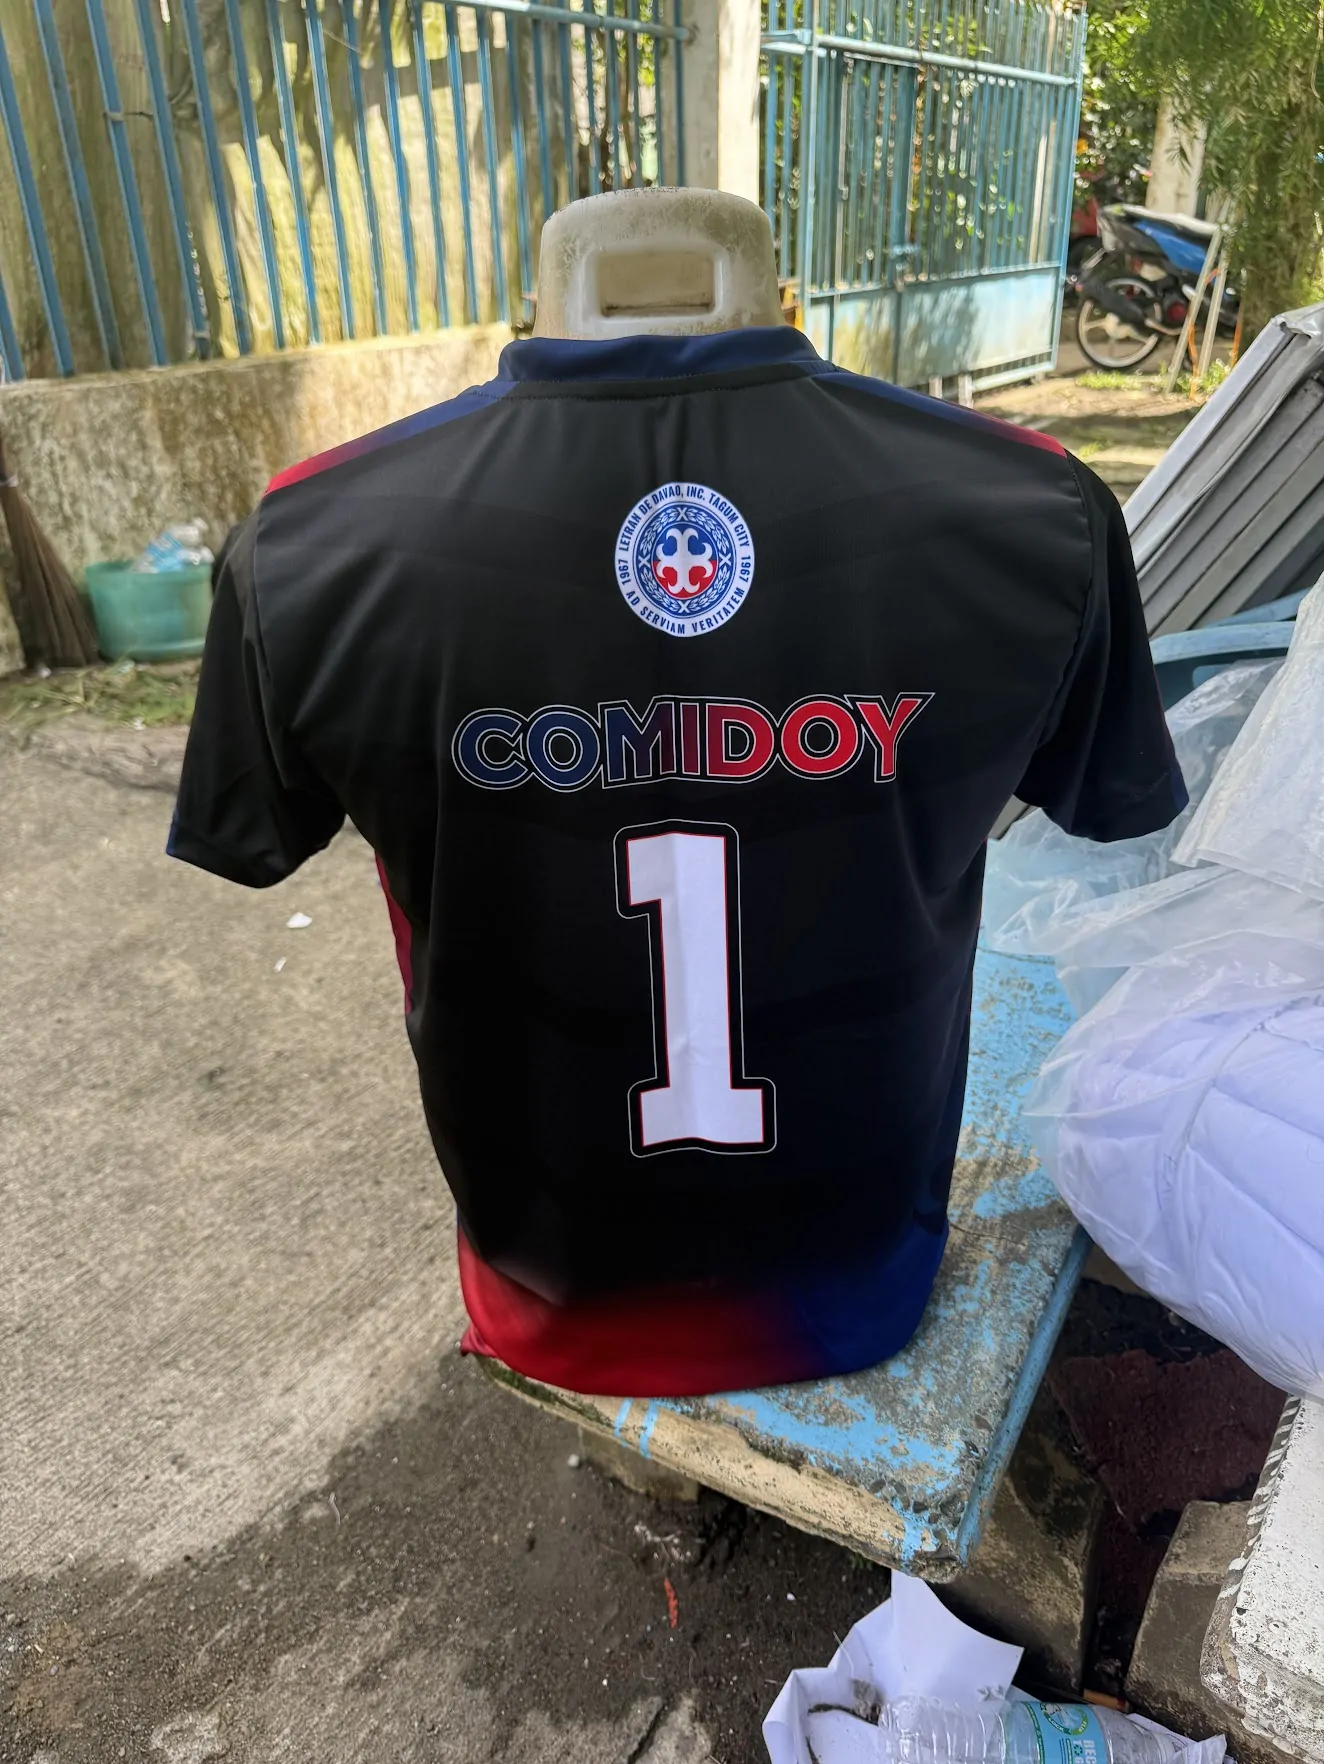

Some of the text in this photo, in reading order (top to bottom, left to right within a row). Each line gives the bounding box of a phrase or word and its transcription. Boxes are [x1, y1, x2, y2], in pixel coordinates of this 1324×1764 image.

[618, 485, 751, 585] 1967 LETRAN DE DAVAO, INC. TAGUM CITY 1967
[626, 587, 745, 634] AD SERVIAM VERITATEM
[454, 693, 932, 791] COMIDOY
[620, 825, 770, 1152] 1
